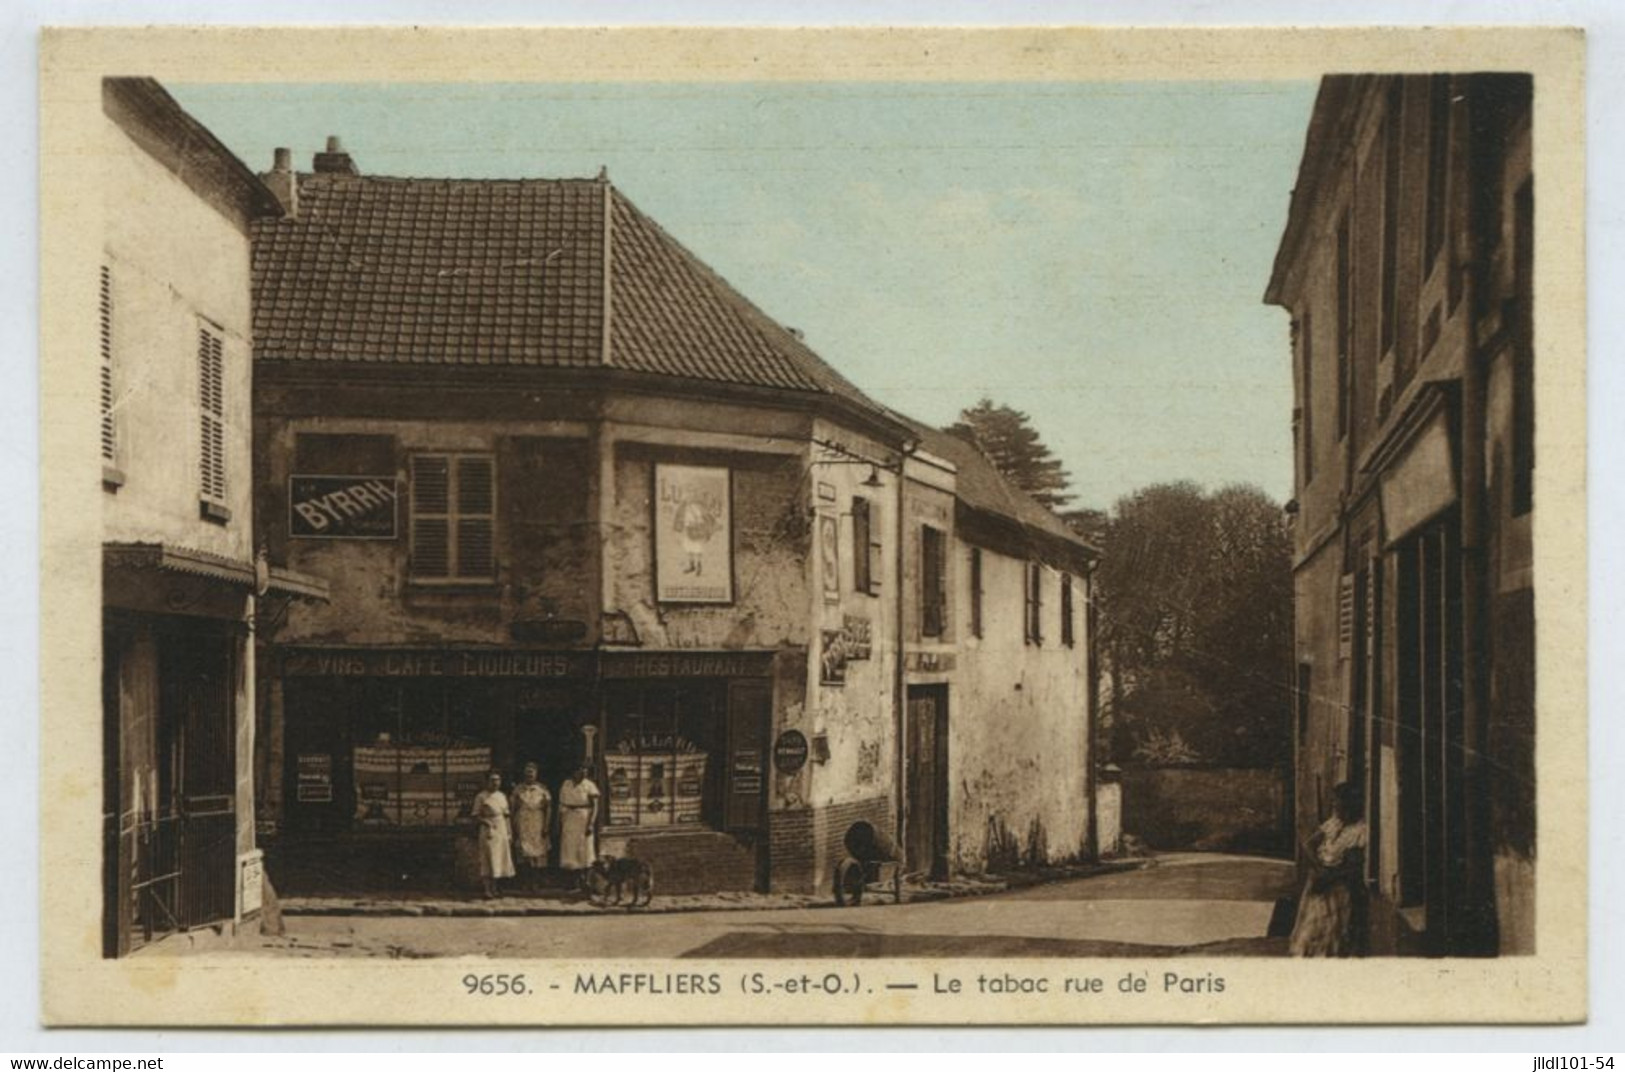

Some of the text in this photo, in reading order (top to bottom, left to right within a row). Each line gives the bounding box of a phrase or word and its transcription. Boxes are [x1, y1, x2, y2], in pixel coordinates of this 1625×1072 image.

[293, 480, 396, 530] BYRRH
[318, 655, 366, 676] VINS
[462, 654, 569, 676] LIQUEURS
[634, 655, 746, 676] RESTAURANT
[462, 973, 534, 995] 9656.
[574, 973, 722, 994] MAFFLIERS
[934, 973, 962, 994] Le
[978, 973, 1049, 994] tabac
[1064, 978, 1104, 994] rue
[1118, 973, 1147, 994] de
[1165, 972, 1226, 994] Paris
